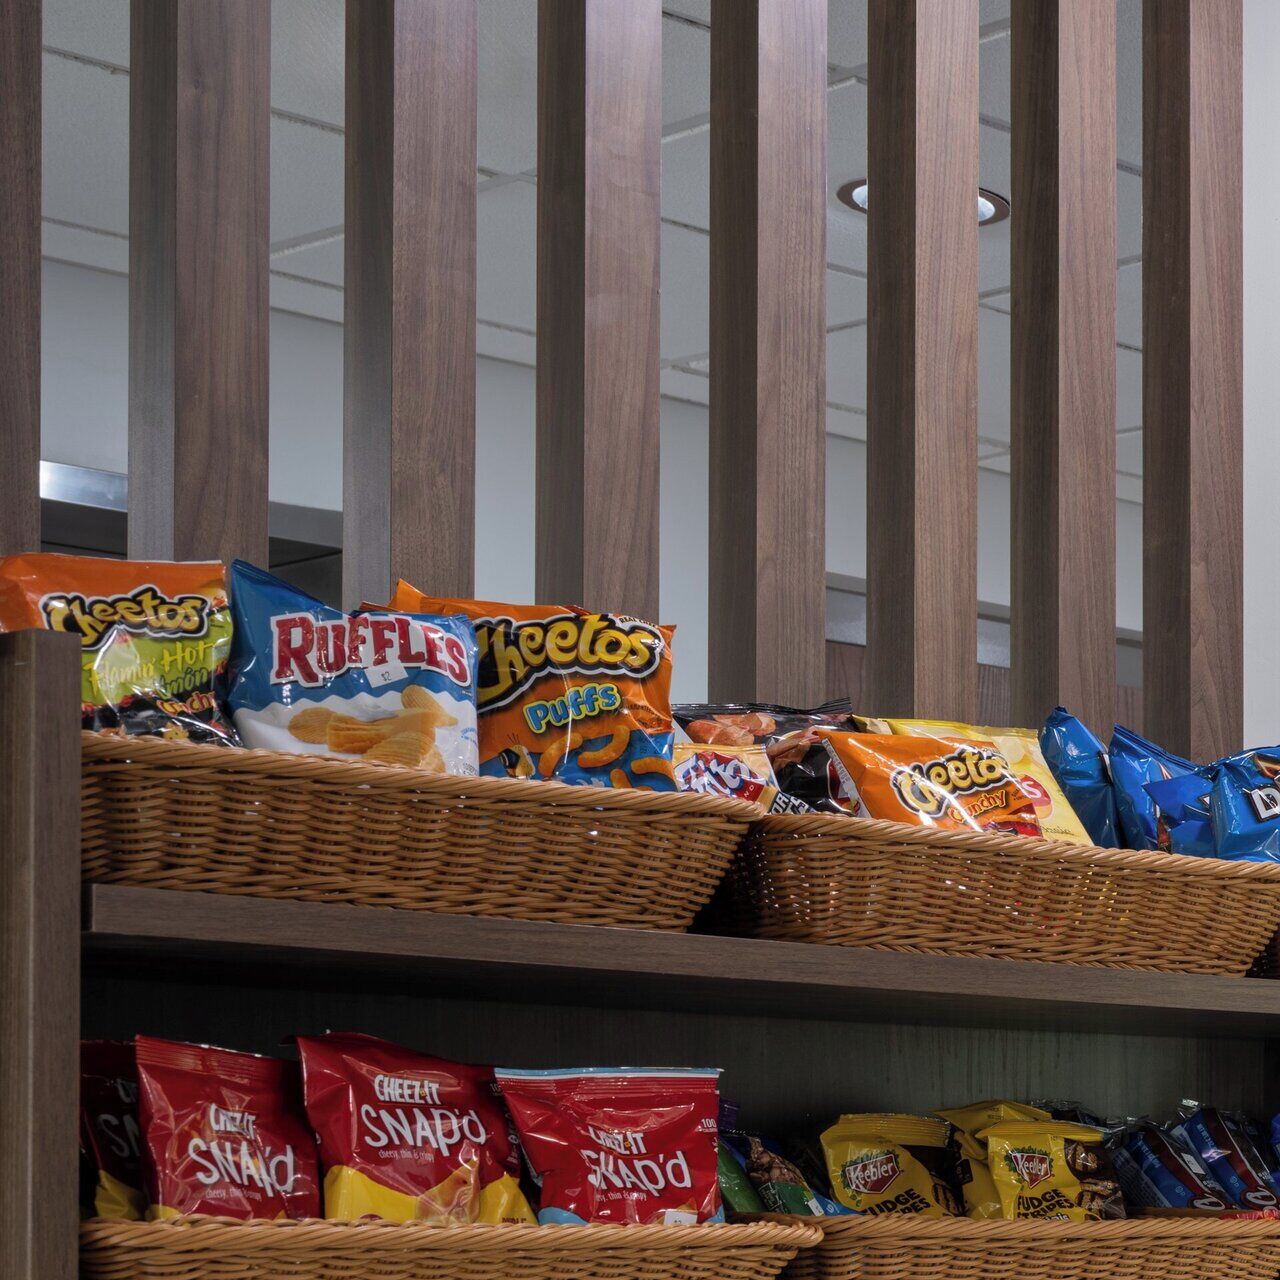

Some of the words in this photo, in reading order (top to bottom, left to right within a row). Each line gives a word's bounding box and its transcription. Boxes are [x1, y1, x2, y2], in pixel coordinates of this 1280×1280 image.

[46, 591, 205, 647] Cheetos
[275, 615, 470, 684] RUFFLES
[478, 615, 655, 698] Cheetos
[527, 684, 618, 730] Puffs
[851, 1160, 894, 1188] Keebler
[1017, 1189, 1067, 1212] FUDGE
